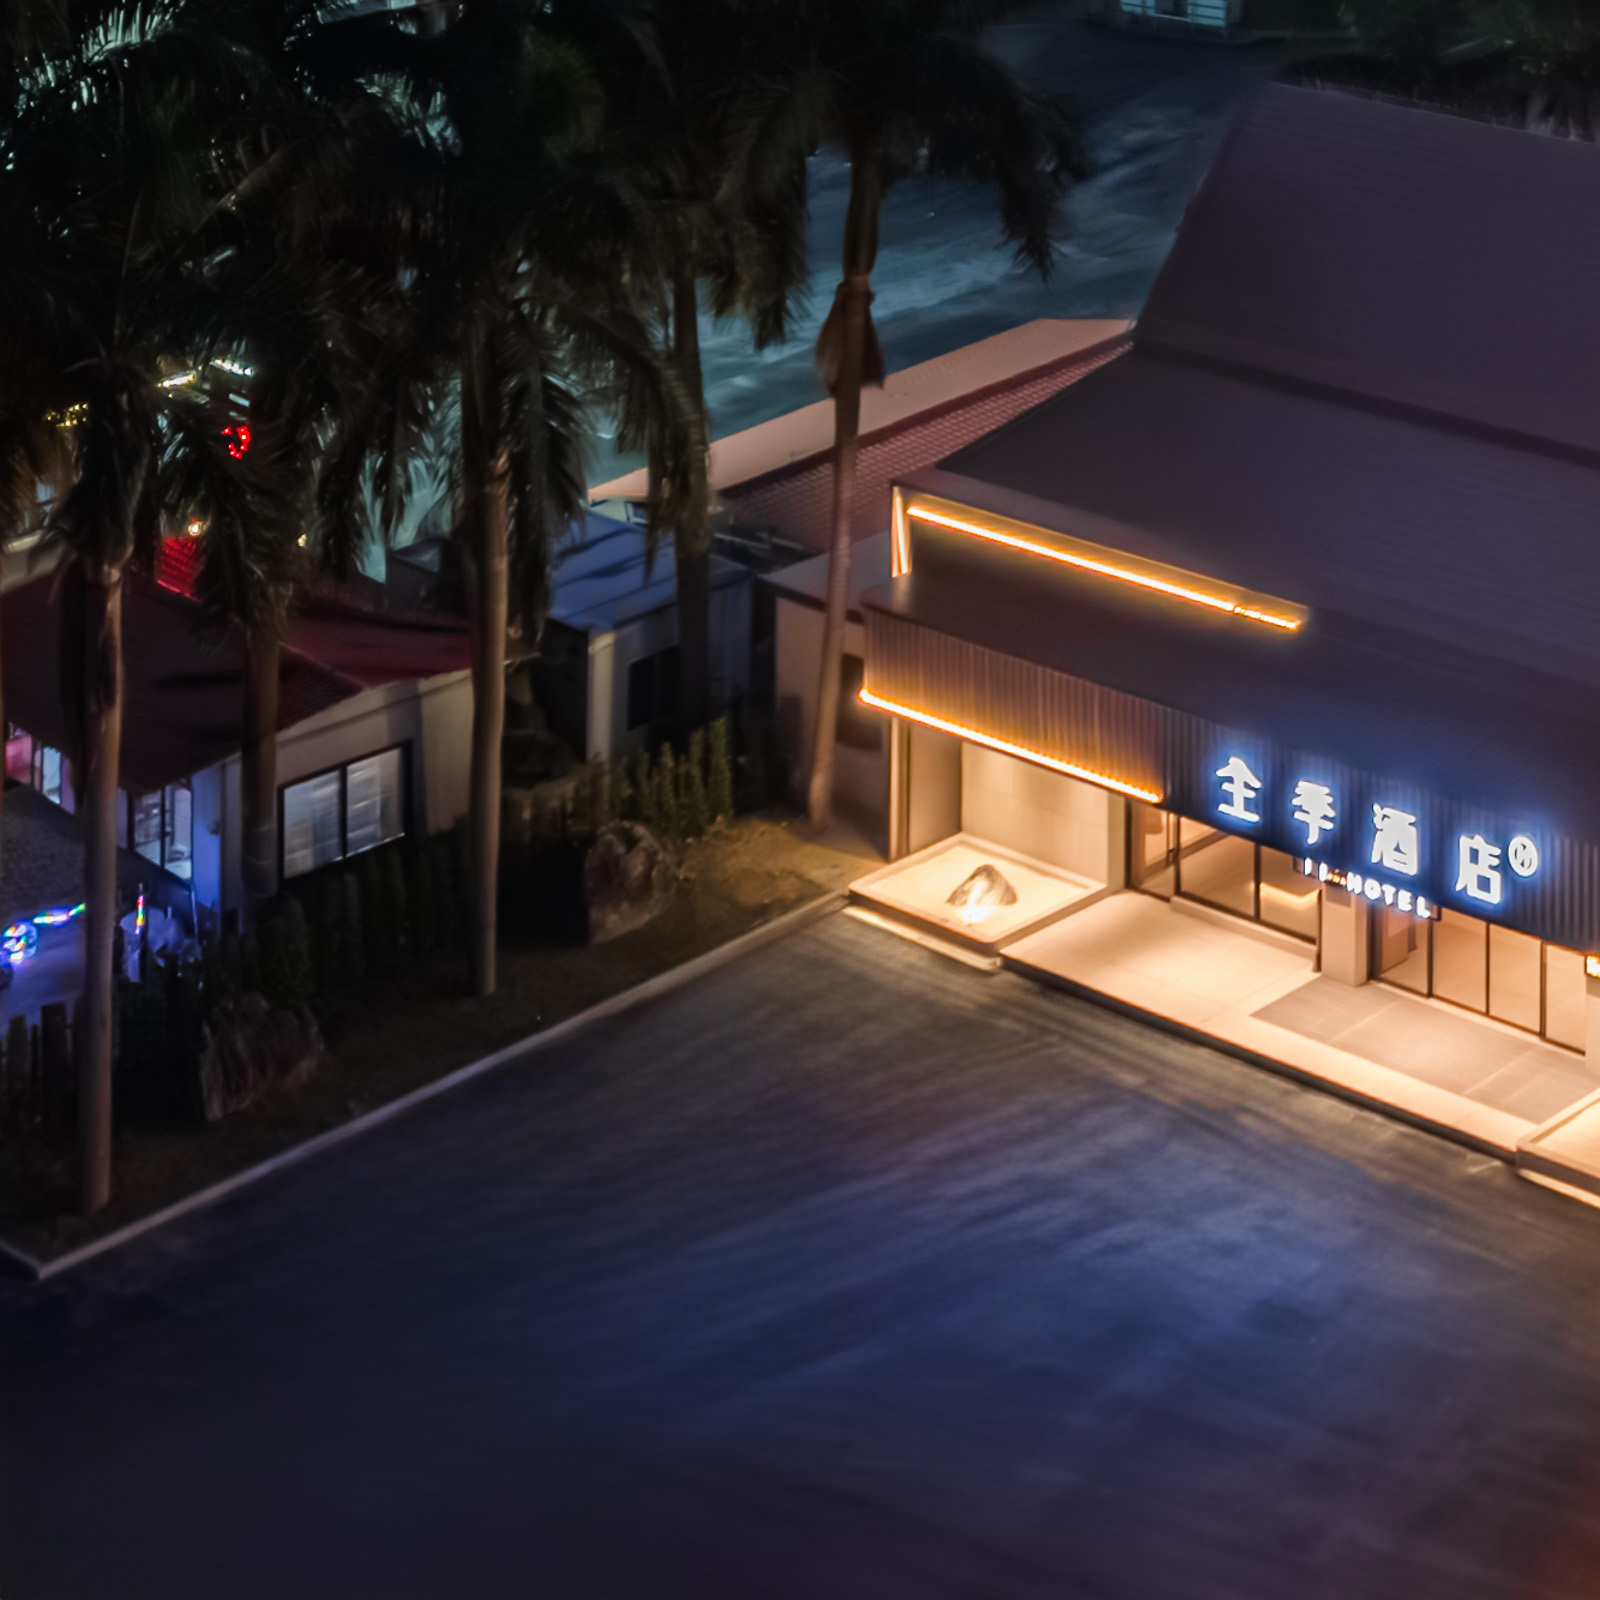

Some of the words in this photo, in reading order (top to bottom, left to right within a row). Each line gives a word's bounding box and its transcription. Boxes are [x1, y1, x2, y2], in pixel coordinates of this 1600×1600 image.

[1214, 755, 1503, 906] 全季酒店
[1345, 870, 1432, 919] HOTEL
